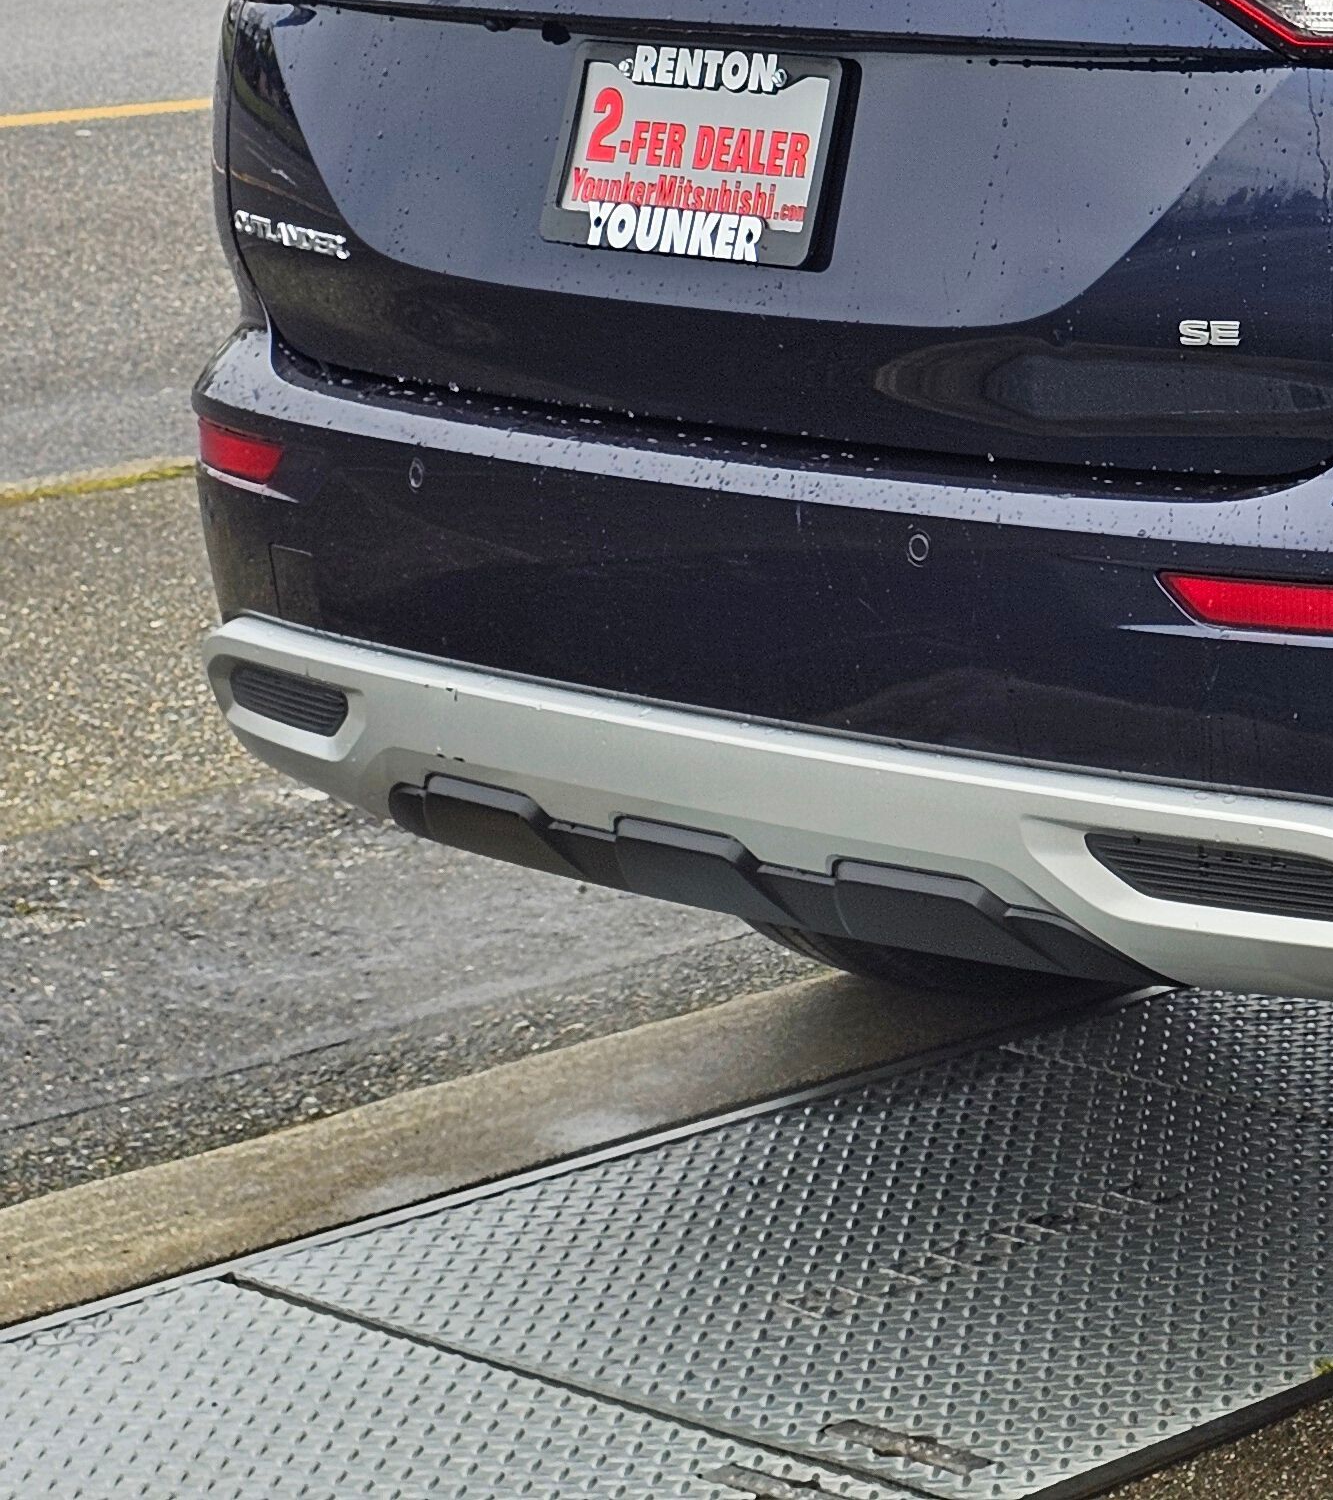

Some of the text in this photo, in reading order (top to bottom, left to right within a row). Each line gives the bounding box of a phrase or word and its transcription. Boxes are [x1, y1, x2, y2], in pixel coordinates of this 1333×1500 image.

[631, 45, 779, 93] RENTON
[586, 87, 811, 179] 2-FER DEALER
[586, 200, 763, 263] YOUNKER
[1179, 320, 1241, 346] SE
